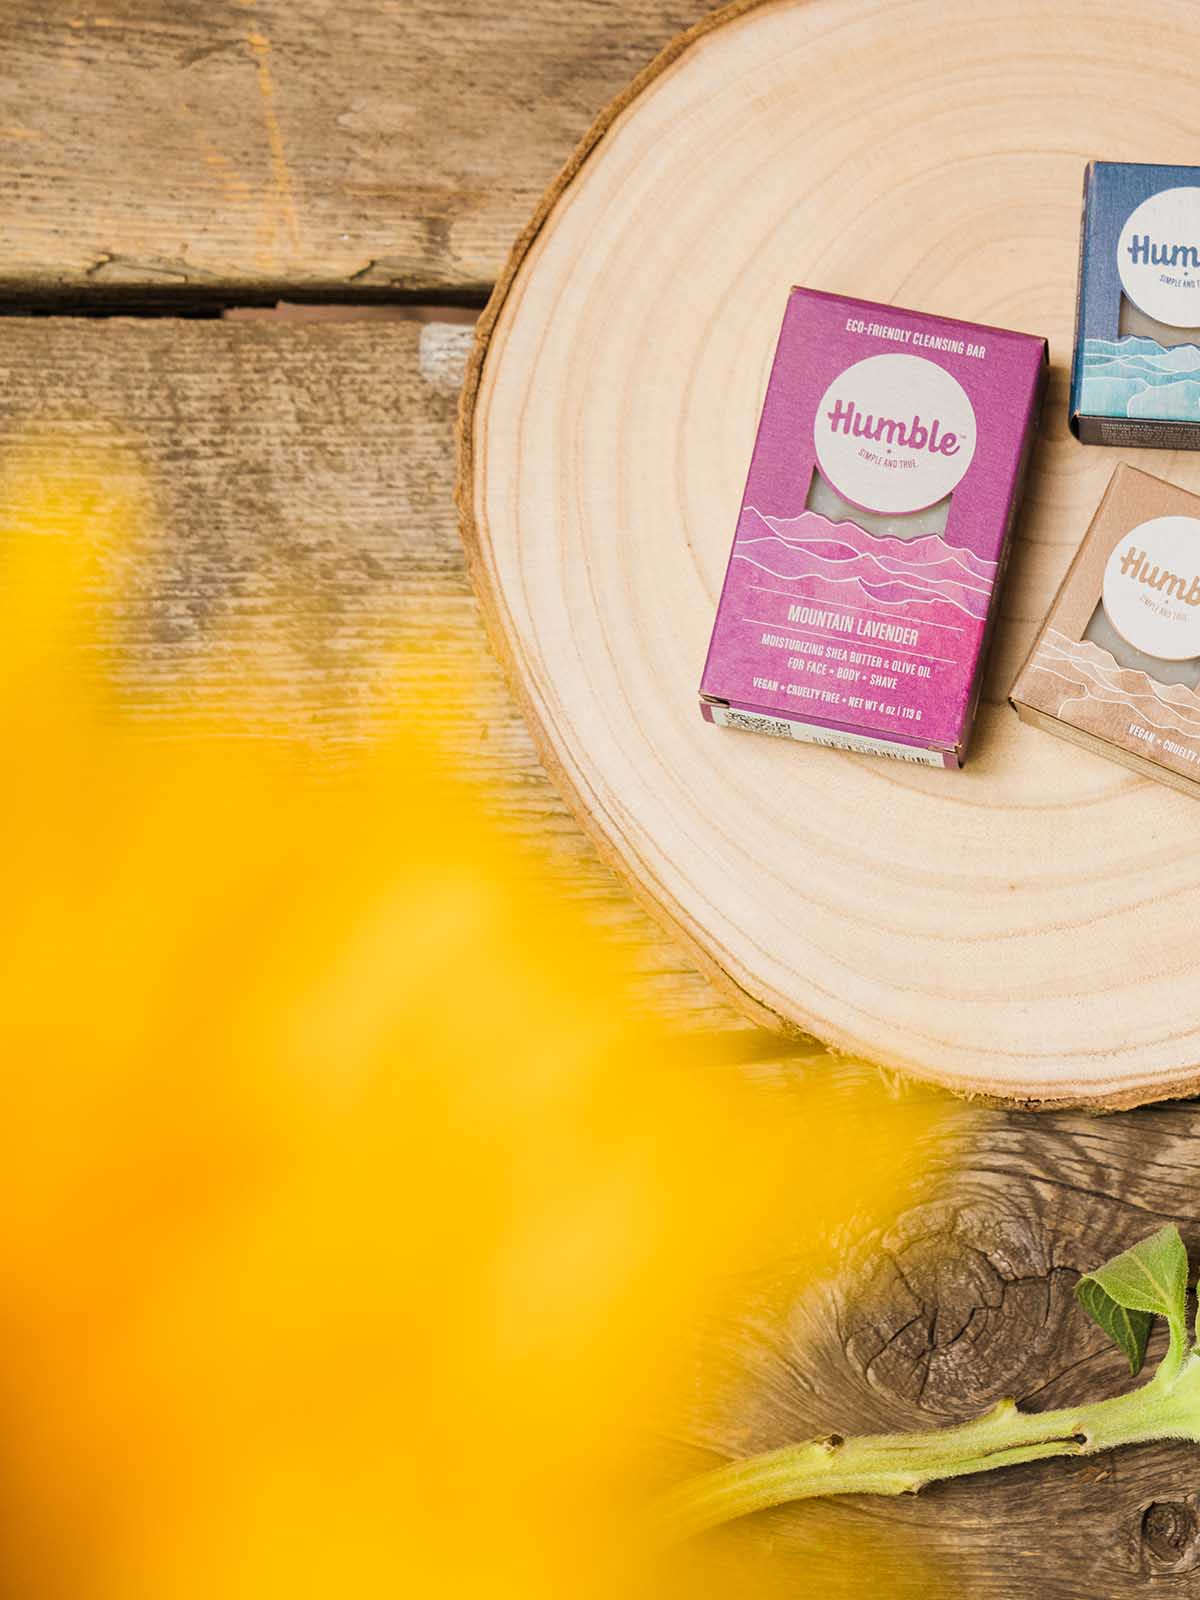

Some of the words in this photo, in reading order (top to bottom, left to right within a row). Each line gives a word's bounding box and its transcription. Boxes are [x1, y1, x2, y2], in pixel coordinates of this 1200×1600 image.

[845, 318, 911, 343] ECO-FRIENDLY
[912, 332, 964, 354] CLEANSING
[966, 343, 986, 358] BAR
[828, 400, 960, 456] Humble
[857, 448, 883, 464] SIMPLE
[883, 458, 897, 468] AND
[787, 604, 854, 633] MOUNTAIN
[856, 618, 918, 646] LAVENDER
[761, 634, 823, 656] MOISTURIZING
[825, 646, 848, 661] SHEA
[849, 651, 882, 668] BUTTER
[890, 659, 916, 675] OLIVE
[917, 664, 932, 678] OIL
[787, 657, 804, 670] FOR
[806, 661, 827, 675] FACE
[836, 667, 859, 681] BODY
[869, 673, 897, 689] SHAVE
[751, 677, 778, 691] VEGAN
[786, 684, 819, 699] CRUELTY
[820, 691, 839, 703] FREE
[847, 696, 863, 708] NET
[864, 699, 878, 711] WT
[878, 702, 884, 712] 4
[885, 704, 895, 714] oz
[901, 707, 914, 718] 113
[915, 710, 921, 720] G
